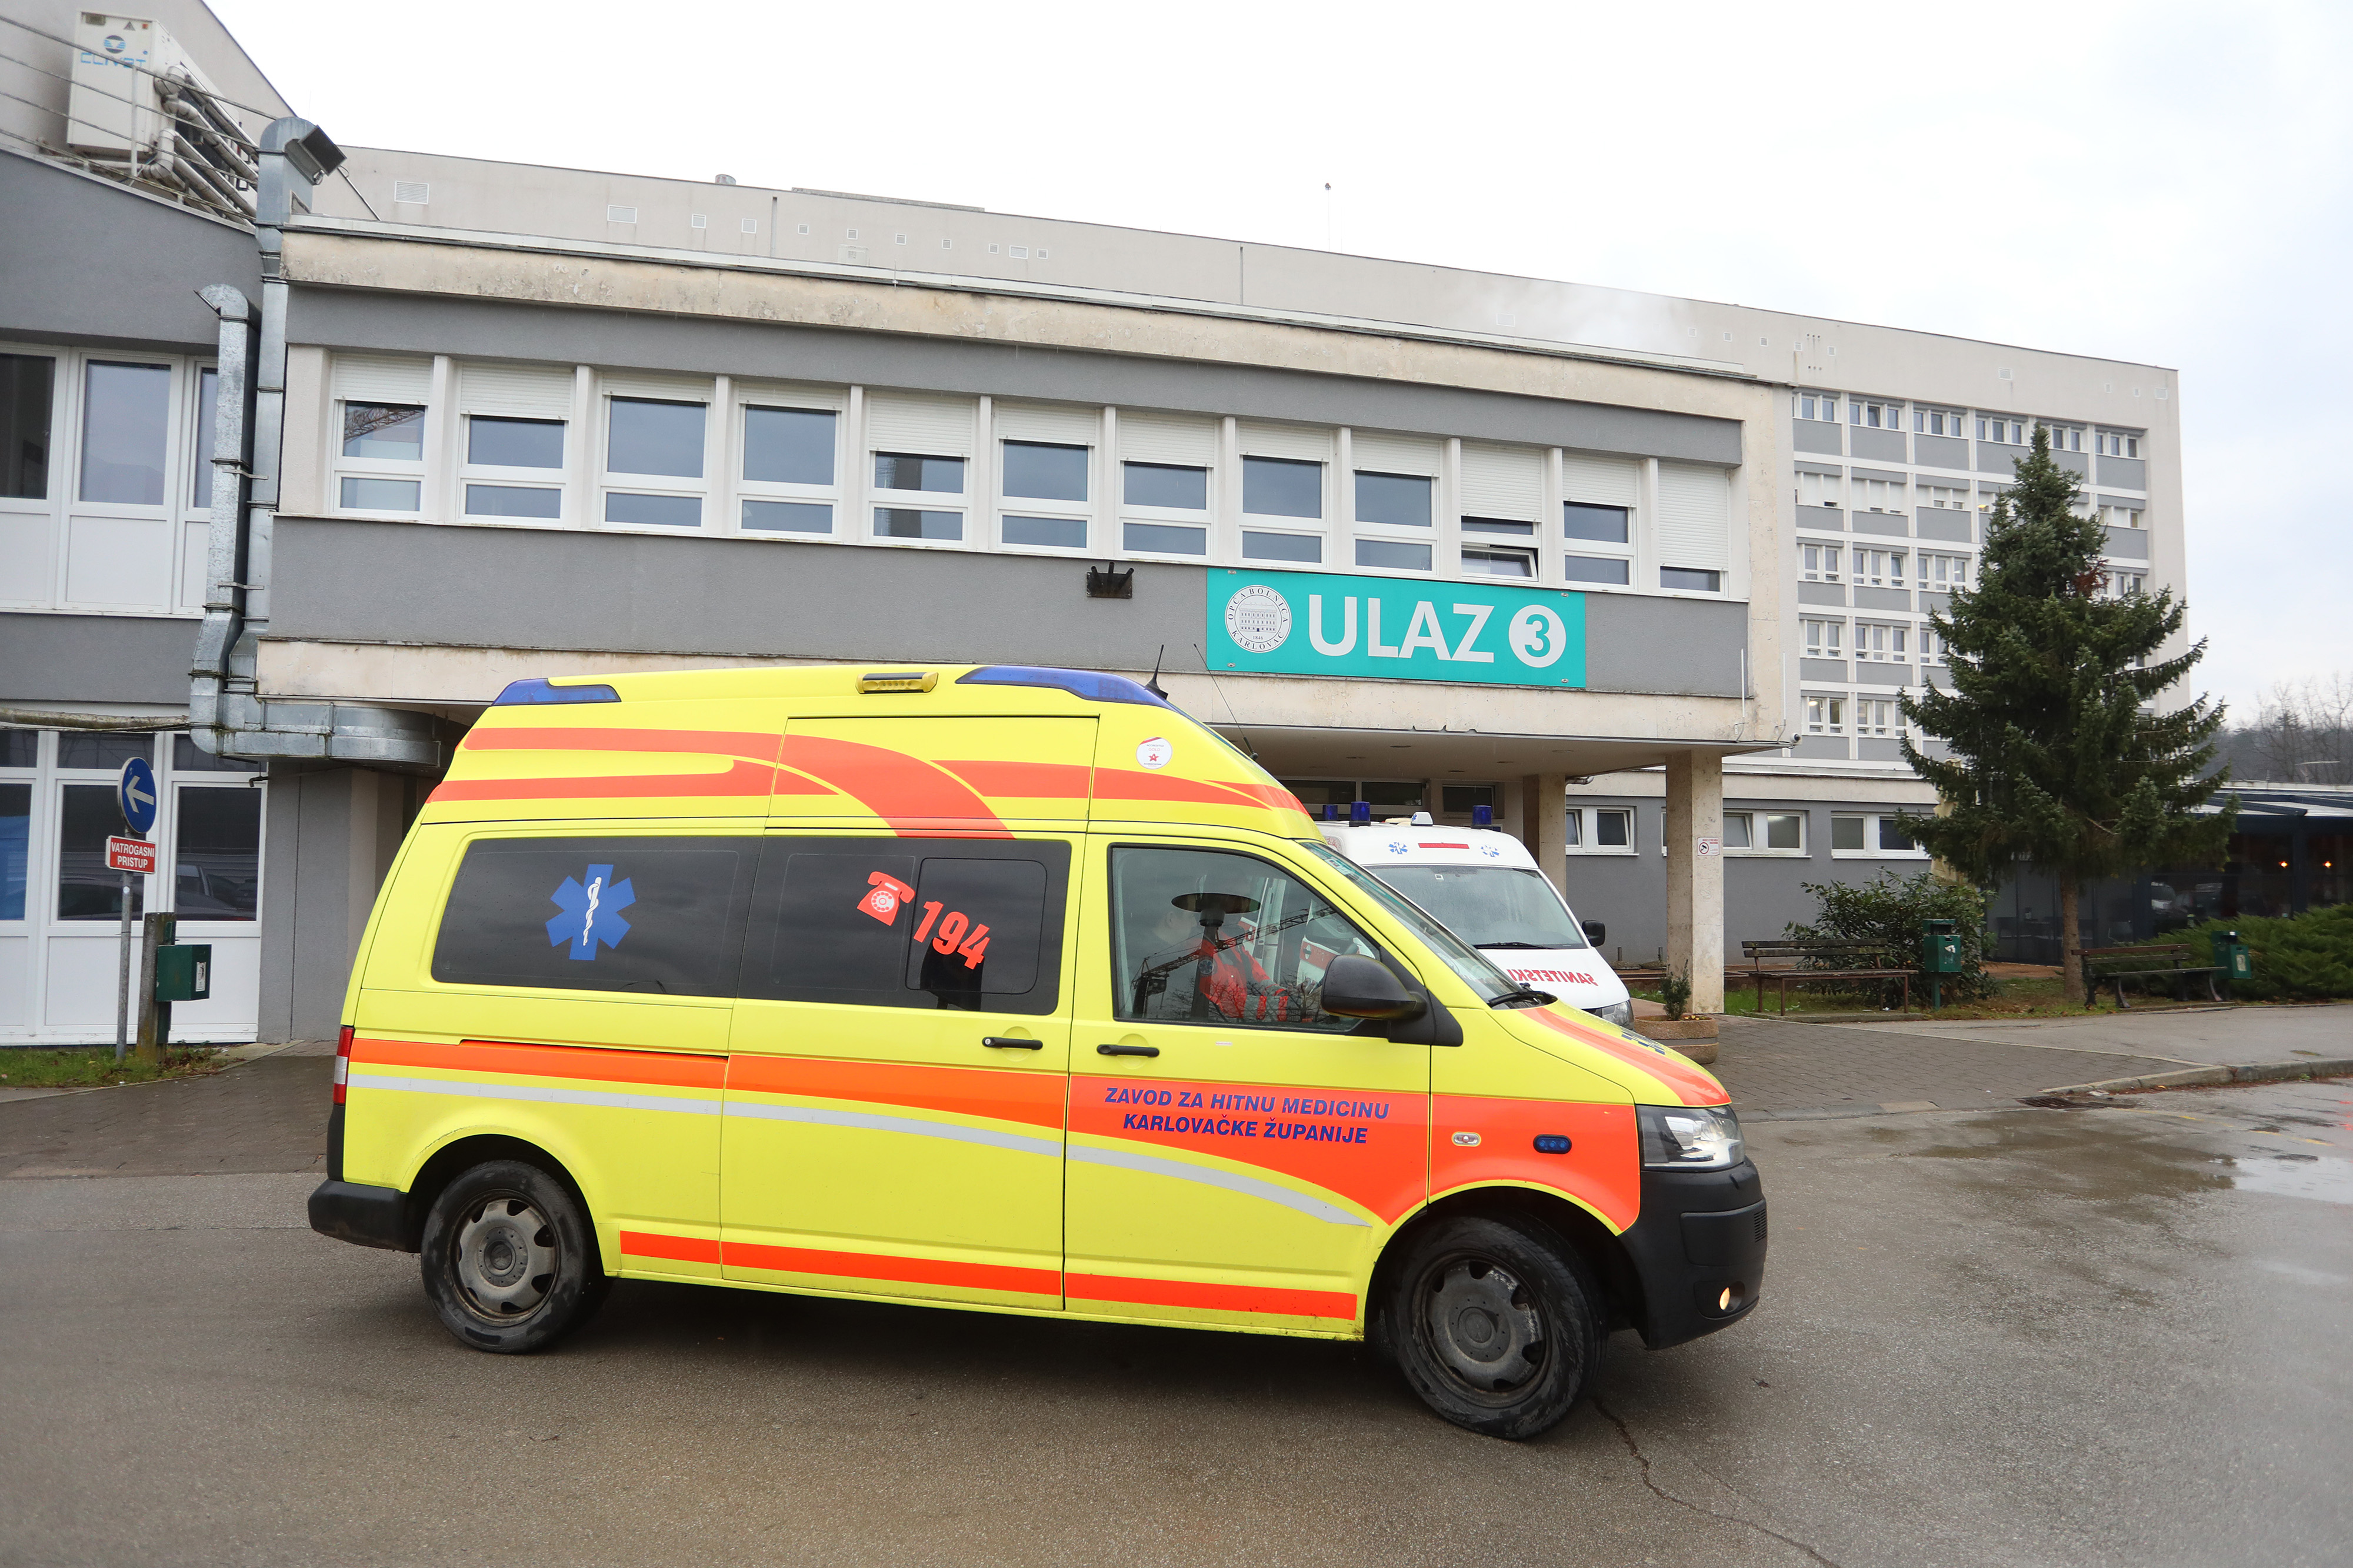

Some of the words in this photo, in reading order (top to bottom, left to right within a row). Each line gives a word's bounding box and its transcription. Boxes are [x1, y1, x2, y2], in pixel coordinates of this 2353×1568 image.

[1249, 588, 1288, 622] BOLNICA
[1232, 630, 1284, 650] KARLOVAC
[1309, 594, 1495, 663] ULAZ
[1524, 613, 1551, 658] 3
[111, 842, 155, 858] VATROGASNI
[117, 855, 148, 868] PRISTUP
[913, 900, 991, 970] 194
[1105, 1087, 1172, 1106] ZAVOD
[1178, 1092, 1203, 1109] ZA
[1211, 1094, 1275, 1112] HITNU
[1282, 1097, 1389, 1119] MEDICINU
[1124, 1113, 1258, 1137] KARLOVAČKE
[1264, 1117, 1368, 1144] ŽUPANIJE
